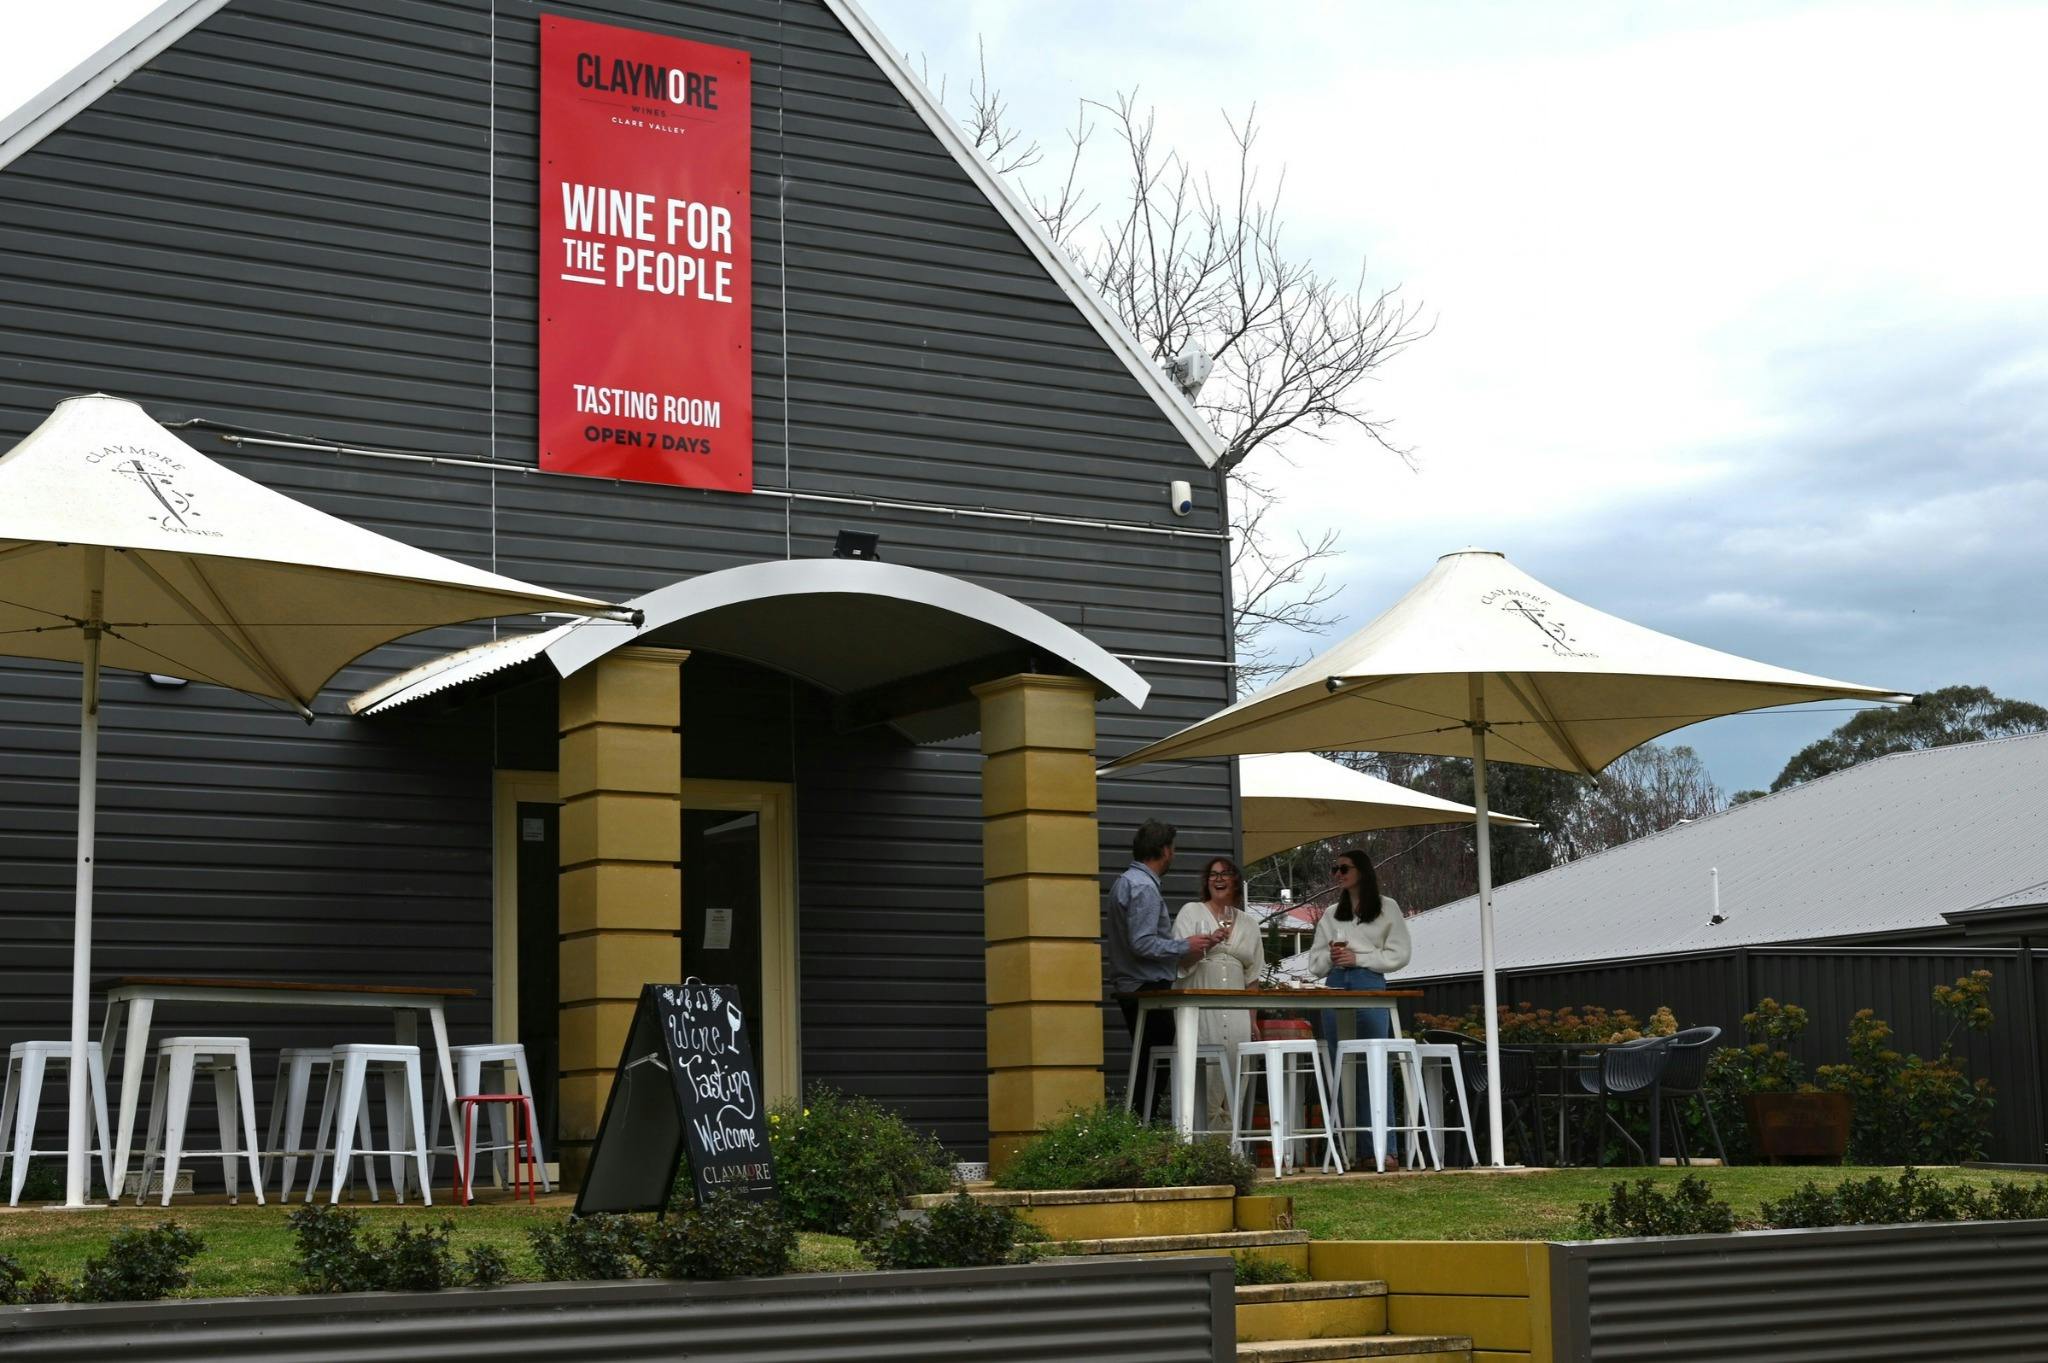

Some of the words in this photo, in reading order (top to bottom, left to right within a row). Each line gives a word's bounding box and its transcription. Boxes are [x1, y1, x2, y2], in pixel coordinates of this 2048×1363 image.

[577, 52, 718, 110] CLAYMORE
[611, 116, 644, 128] CLARE
[649, 122, 686, 135] VALLEY
[631, 105, 667, 118] WINES
[561, 182, 656, 242] WINE
[667, 198, 732, 254] FOR
[562, 238, 606, 272] THE
[616, 245, 733, 304] PEOPLE
[573, 384, 658, 421] TASTING
[664, 395, 721, 429] ROOM
[85, 445, 186, 471] CLAYMORE
[584, 425, 642, 448] OPEN
[646, 432, 657, 449] 7
[661, 434, 711, 455] DAYS
[669, 1011, 724, 1056] Wine
[679, 1054, 755, 1120] Tasting
[694, 1113, 760, 1156] Welcome
